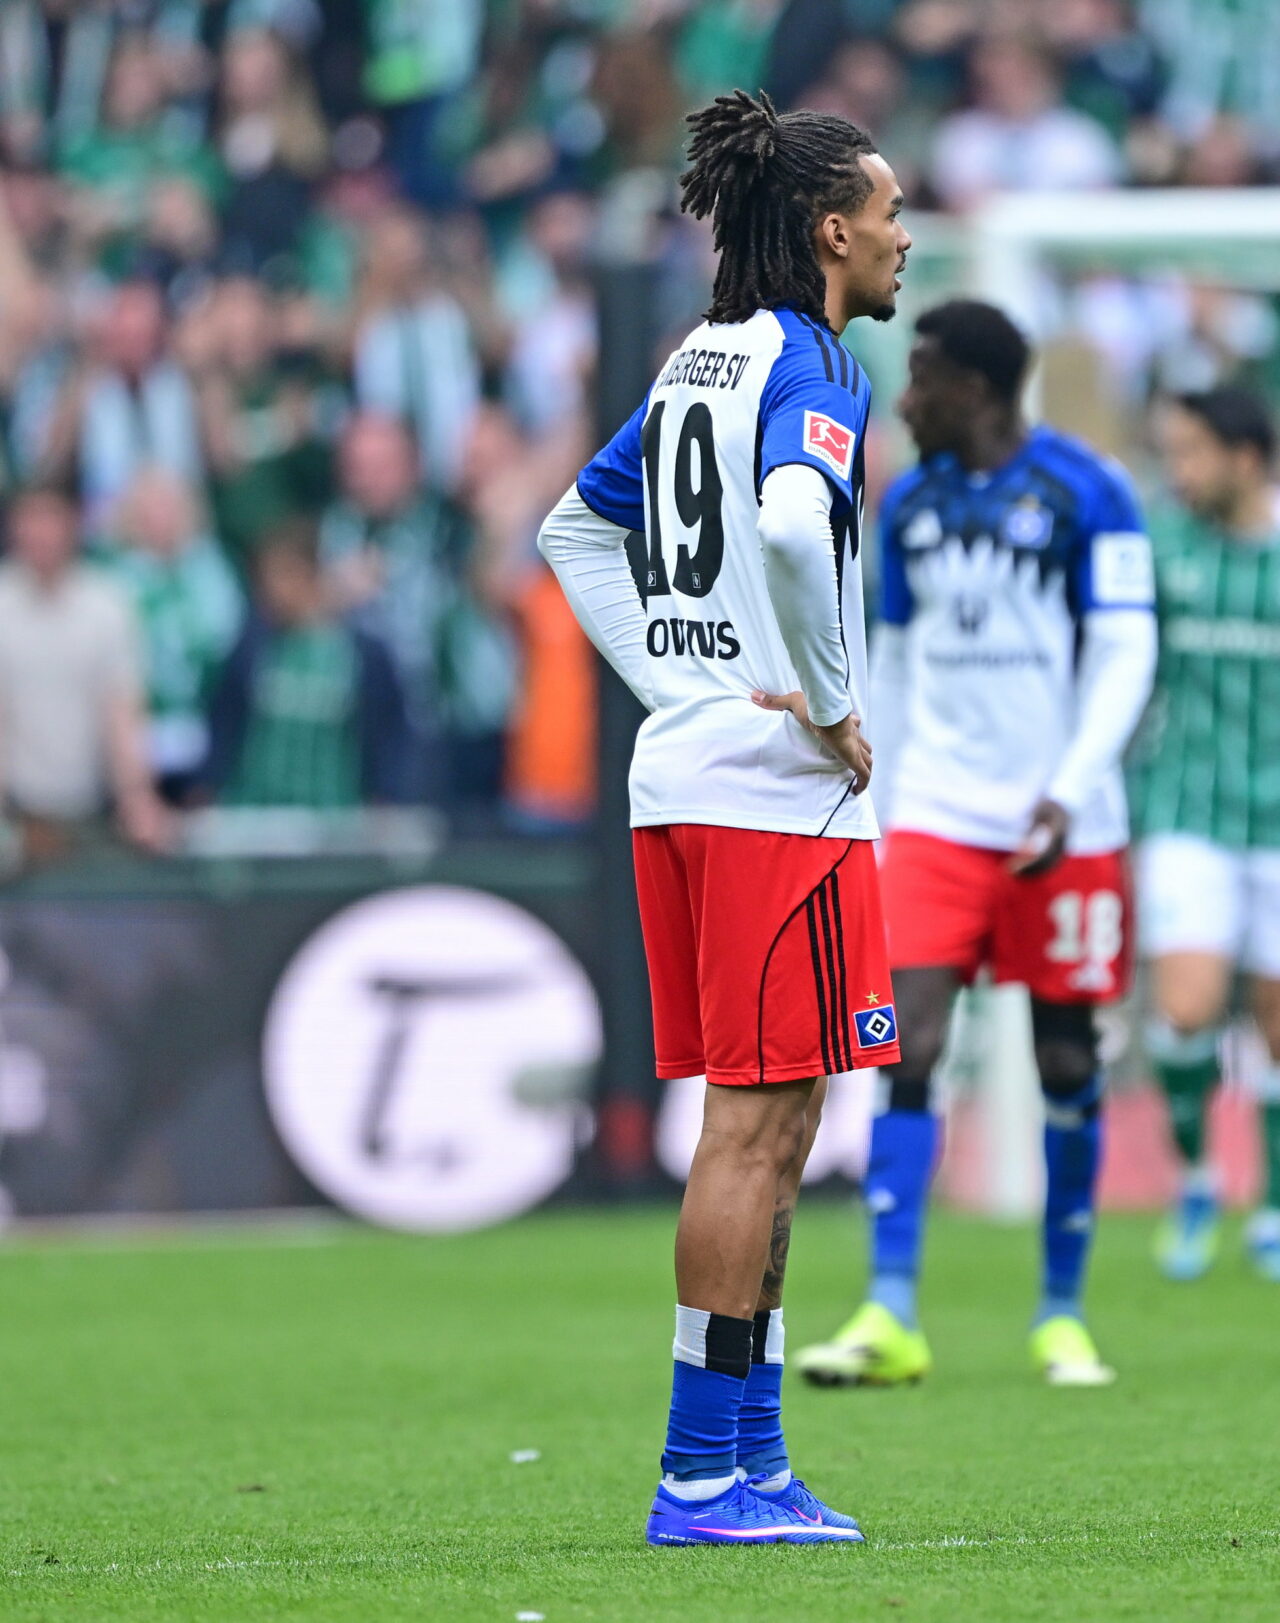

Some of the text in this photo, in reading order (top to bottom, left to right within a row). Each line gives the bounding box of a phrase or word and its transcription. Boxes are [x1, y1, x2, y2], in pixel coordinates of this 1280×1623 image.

[719, 353, 751, 390] SV
[642, 400, 725, 598] 19
[1045, 889, 1124, 963] 18
